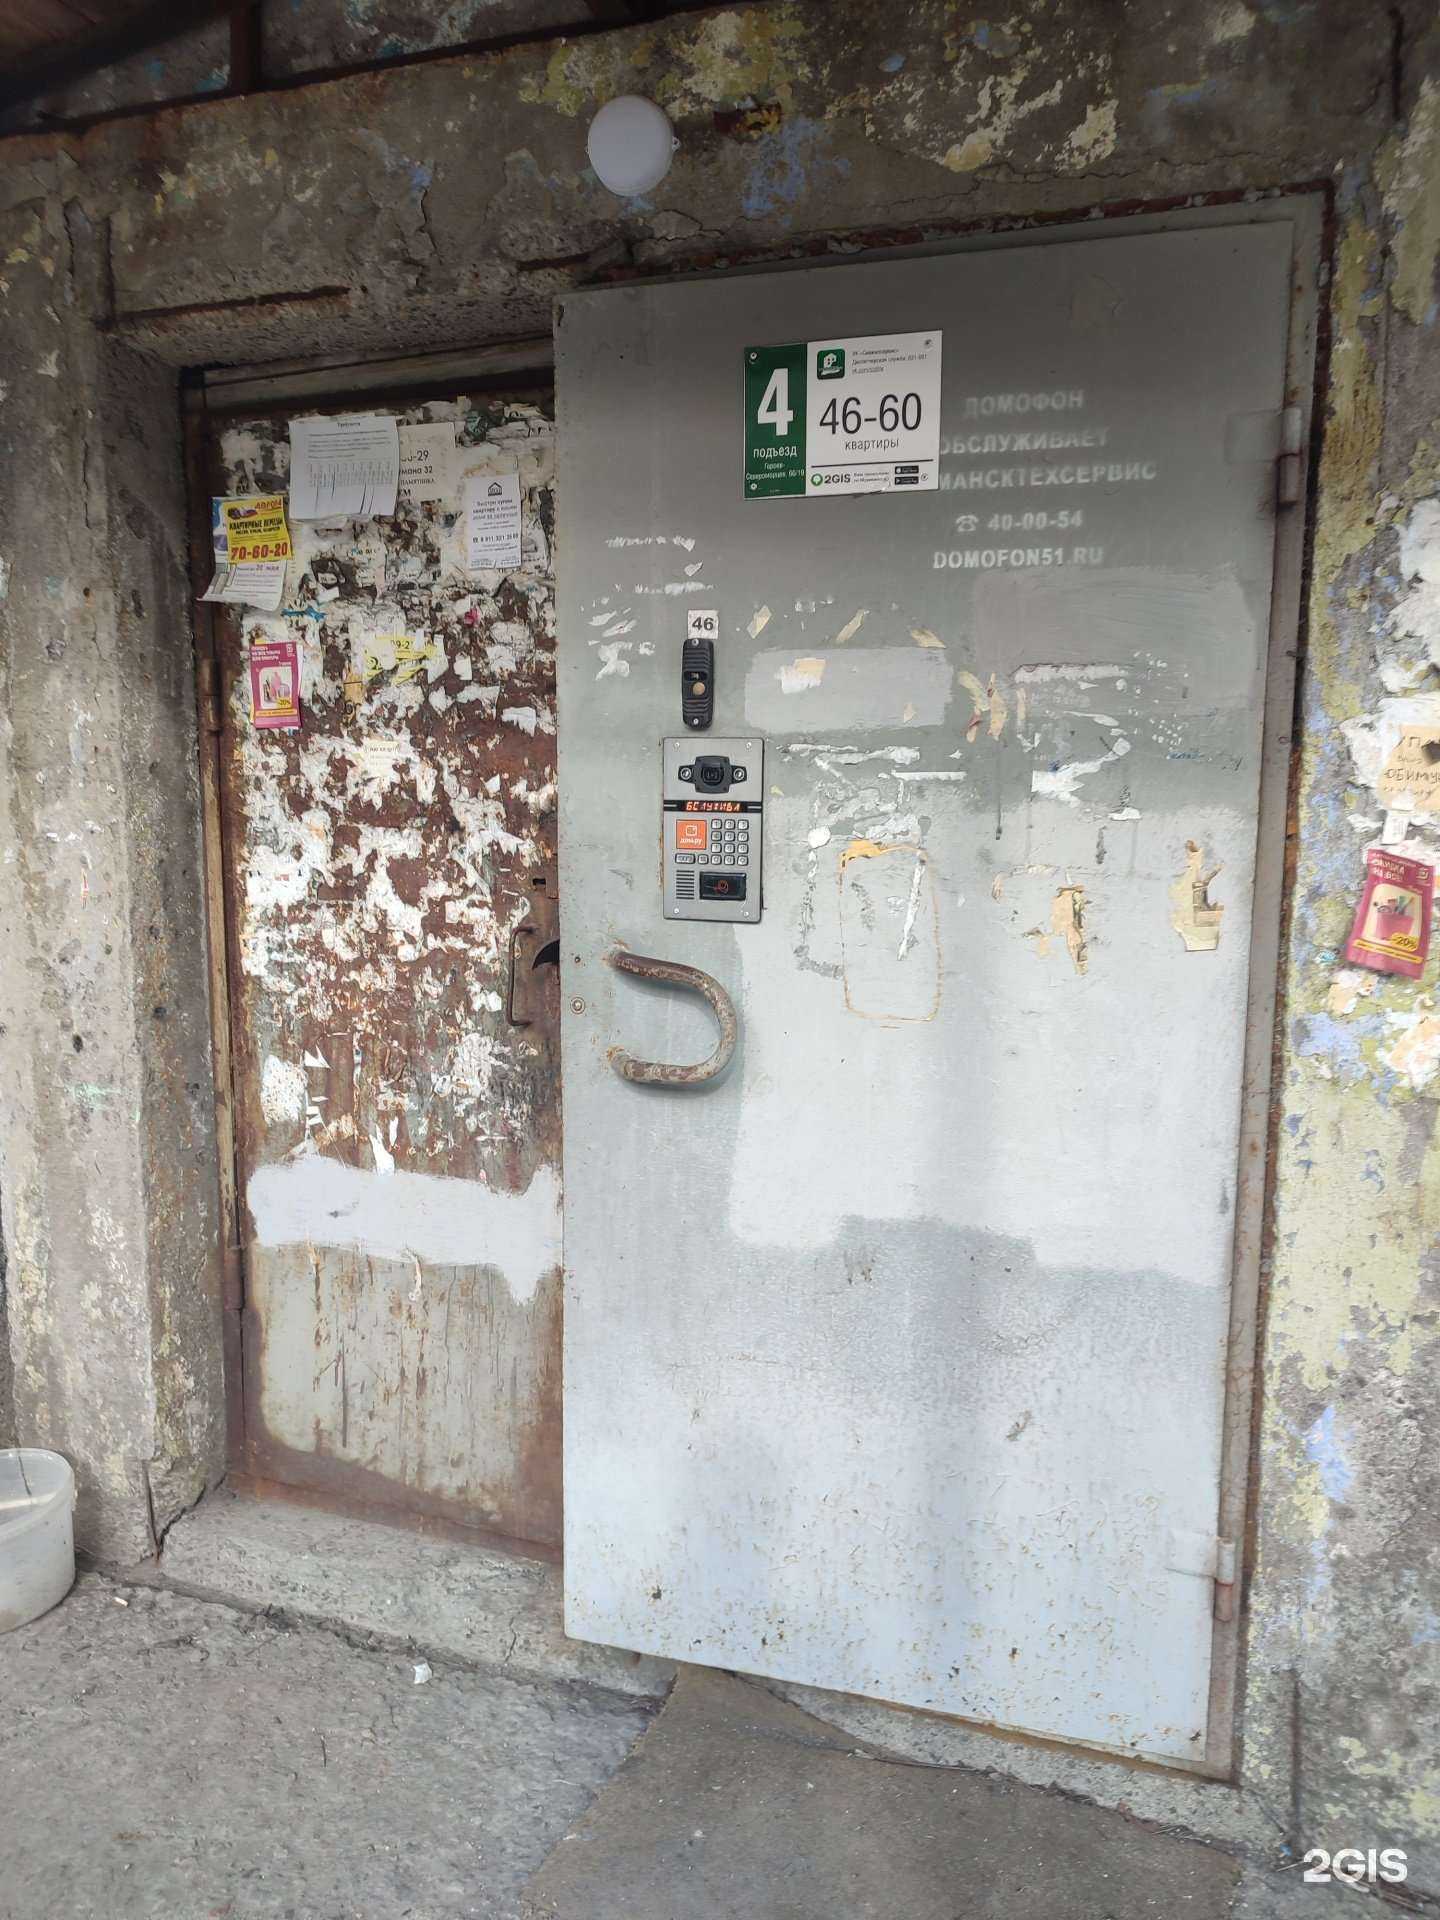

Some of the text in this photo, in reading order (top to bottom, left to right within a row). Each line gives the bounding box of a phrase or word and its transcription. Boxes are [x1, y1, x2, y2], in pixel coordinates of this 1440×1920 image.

[757, 367, 794, 436] 4
[819, 392, 922, 434] 46-60
[964, 390, 1085, 419] ДОМОФОН
[845, 439, 899, 451] квартиры
[939, 427, 1109, 455] ОБСЛУЖИВАЕТ
[753, 446, 798, 460] подъезд
[824, 473, 851, 484] 2GIS
[939, 461, 1158, 491] МАНСКТЕХСЕРВИС
[987, 510, 1083, 532] 40-00-54
[933, 546, 1104, 569] DOMOFON51.RU
[692, 616, 714, 631] 46
